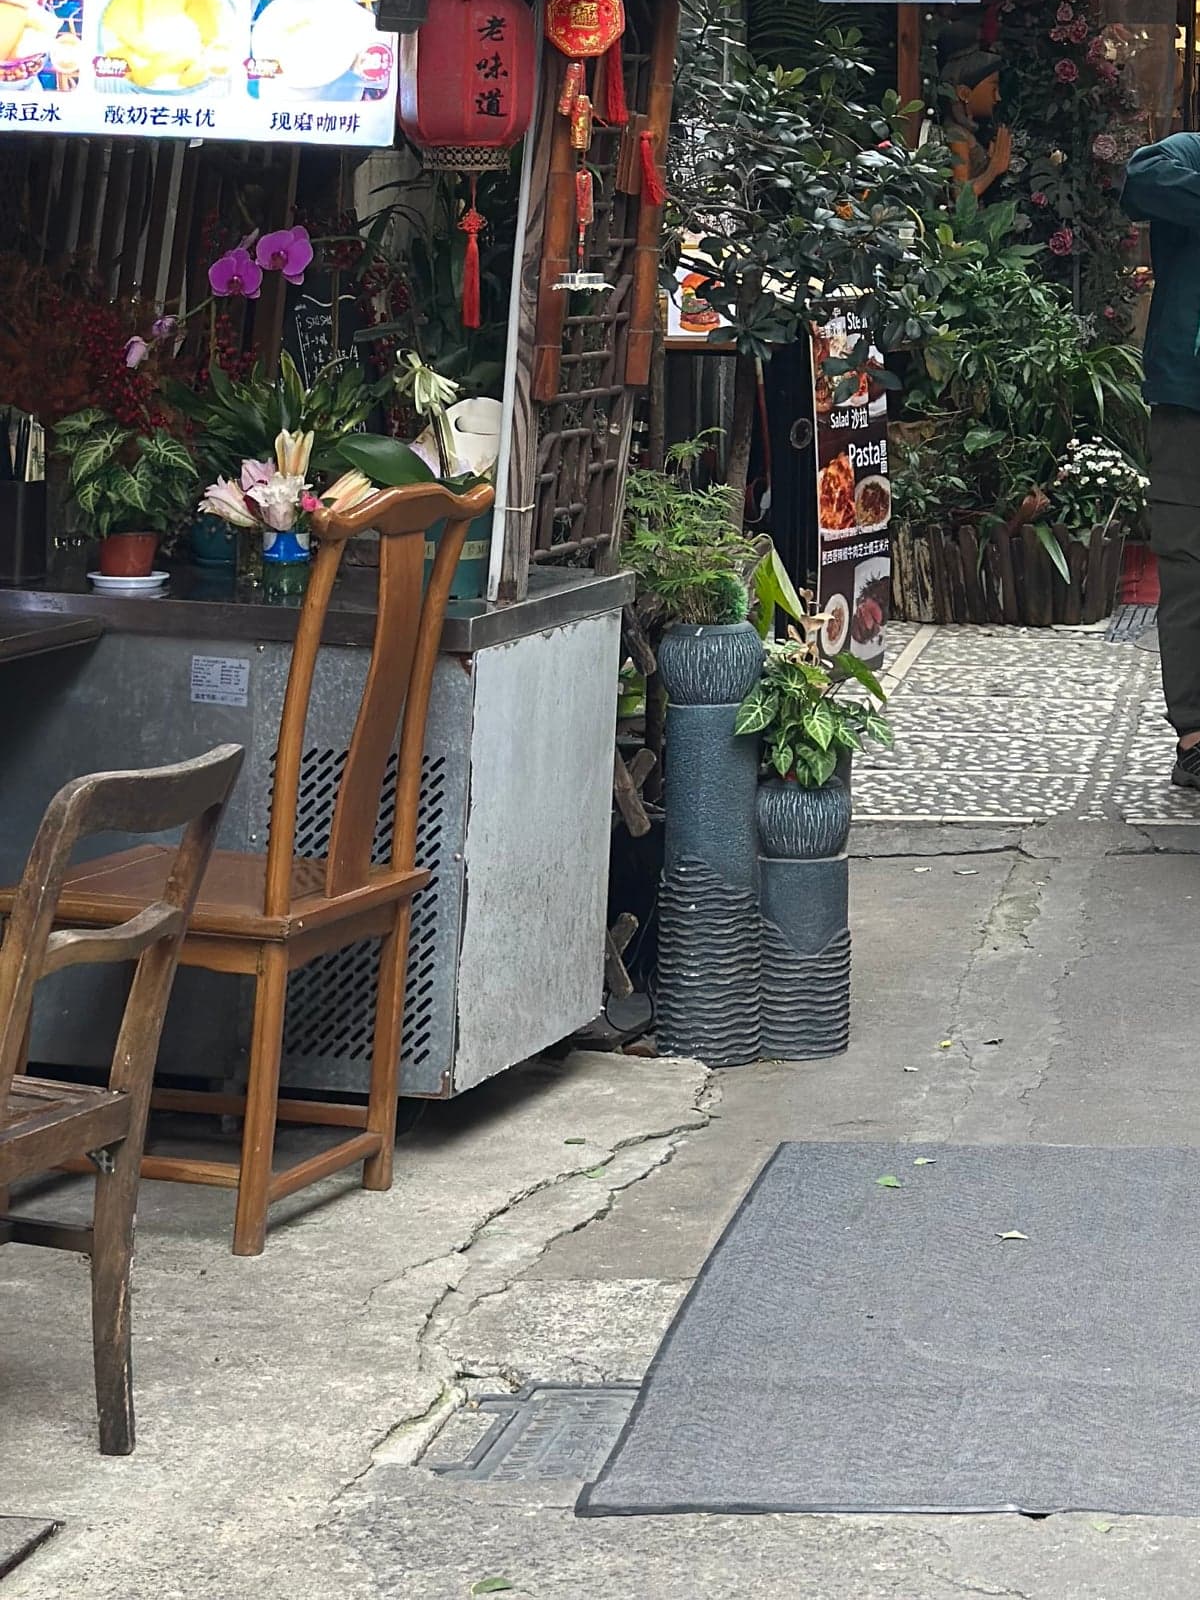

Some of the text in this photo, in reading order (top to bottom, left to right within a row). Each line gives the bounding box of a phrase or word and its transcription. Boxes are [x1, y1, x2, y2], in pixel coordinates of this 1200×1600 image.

[476, 14, 509, 118] 老味道
[0, 102, 62, 122] 绿豆冰
[104, 104, 215, 129] 酸奶芒果优
[269, 111, 361, 134] 现磨咖啡
[830, 411, 850, 429] Salad
[848, 441, 880, 468] Pasta
